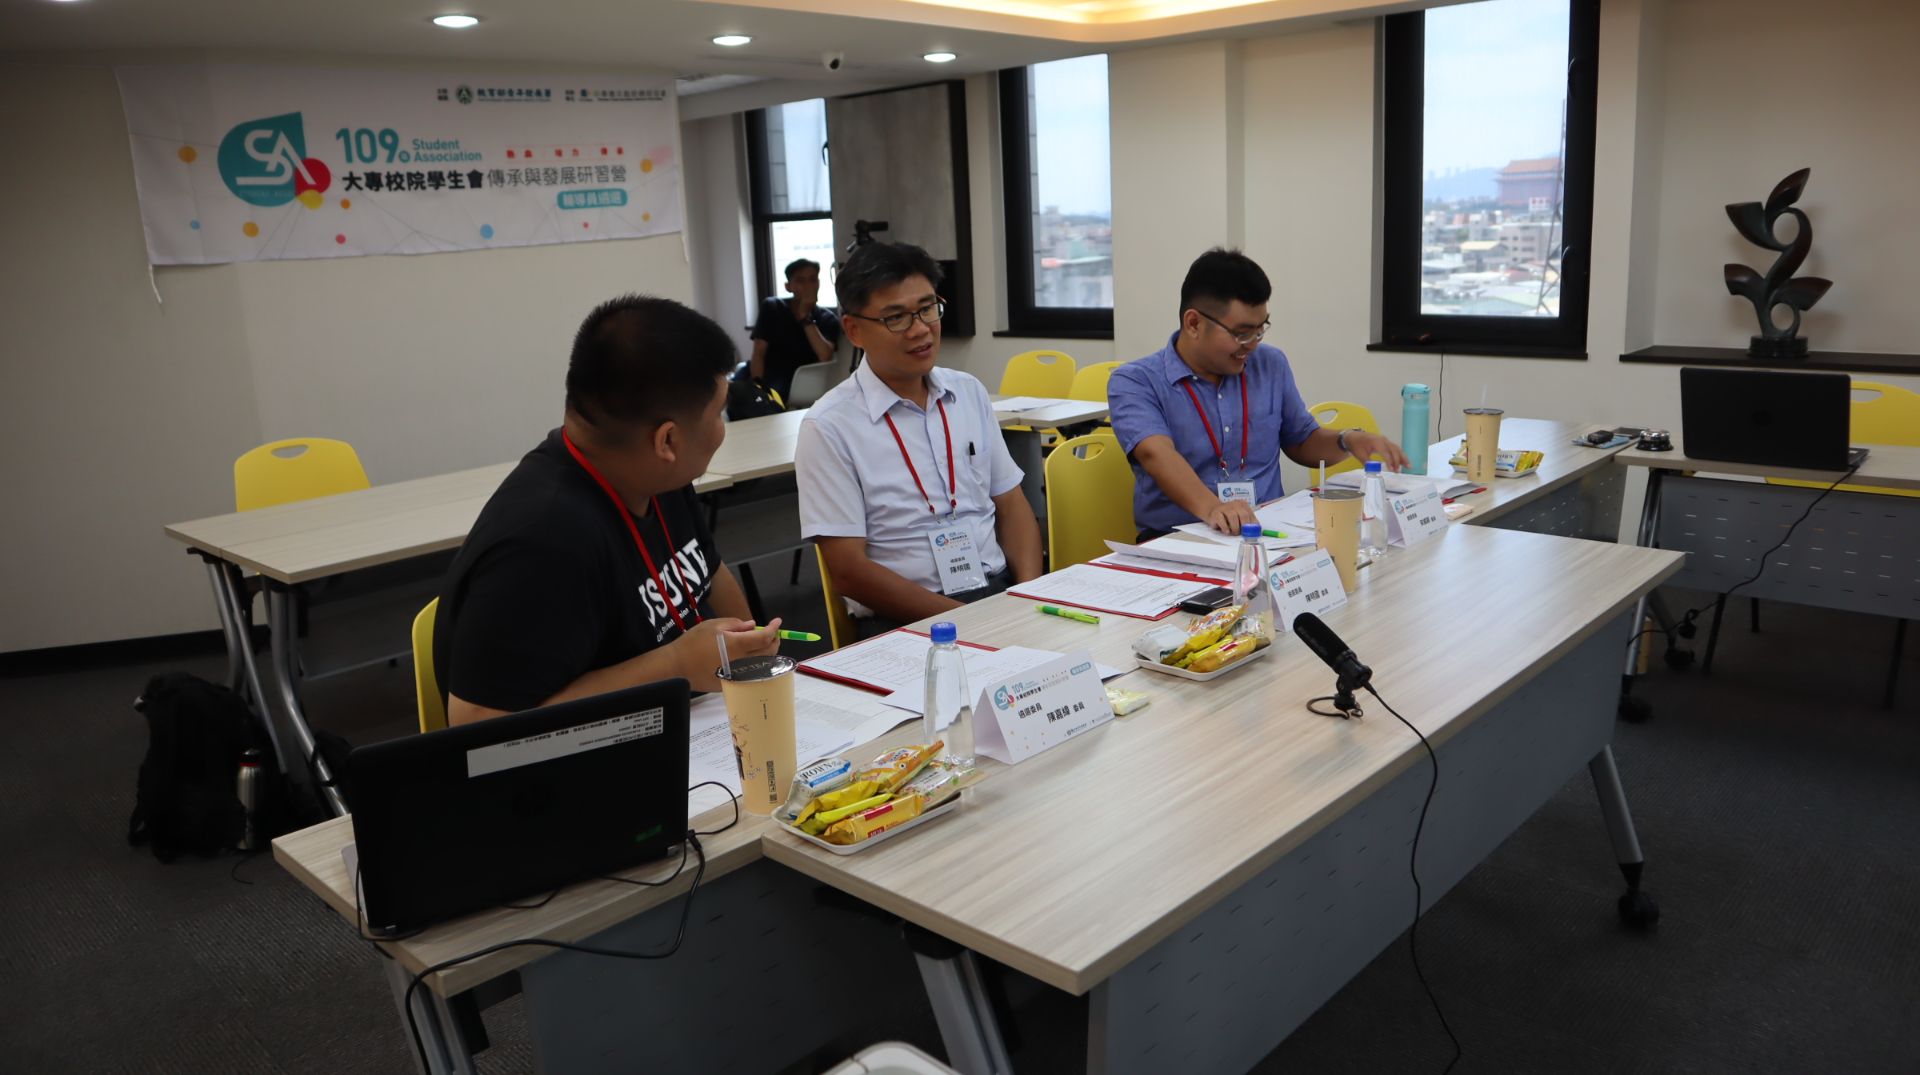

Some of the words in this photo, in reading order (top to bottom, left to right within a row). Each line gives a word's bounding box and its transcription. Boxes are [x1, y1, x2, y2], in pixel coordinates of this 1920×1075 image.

[335, 128, 399, 164] 109
[412, 138, 460, 151] Student
[414, 149, 483, 163] Association
